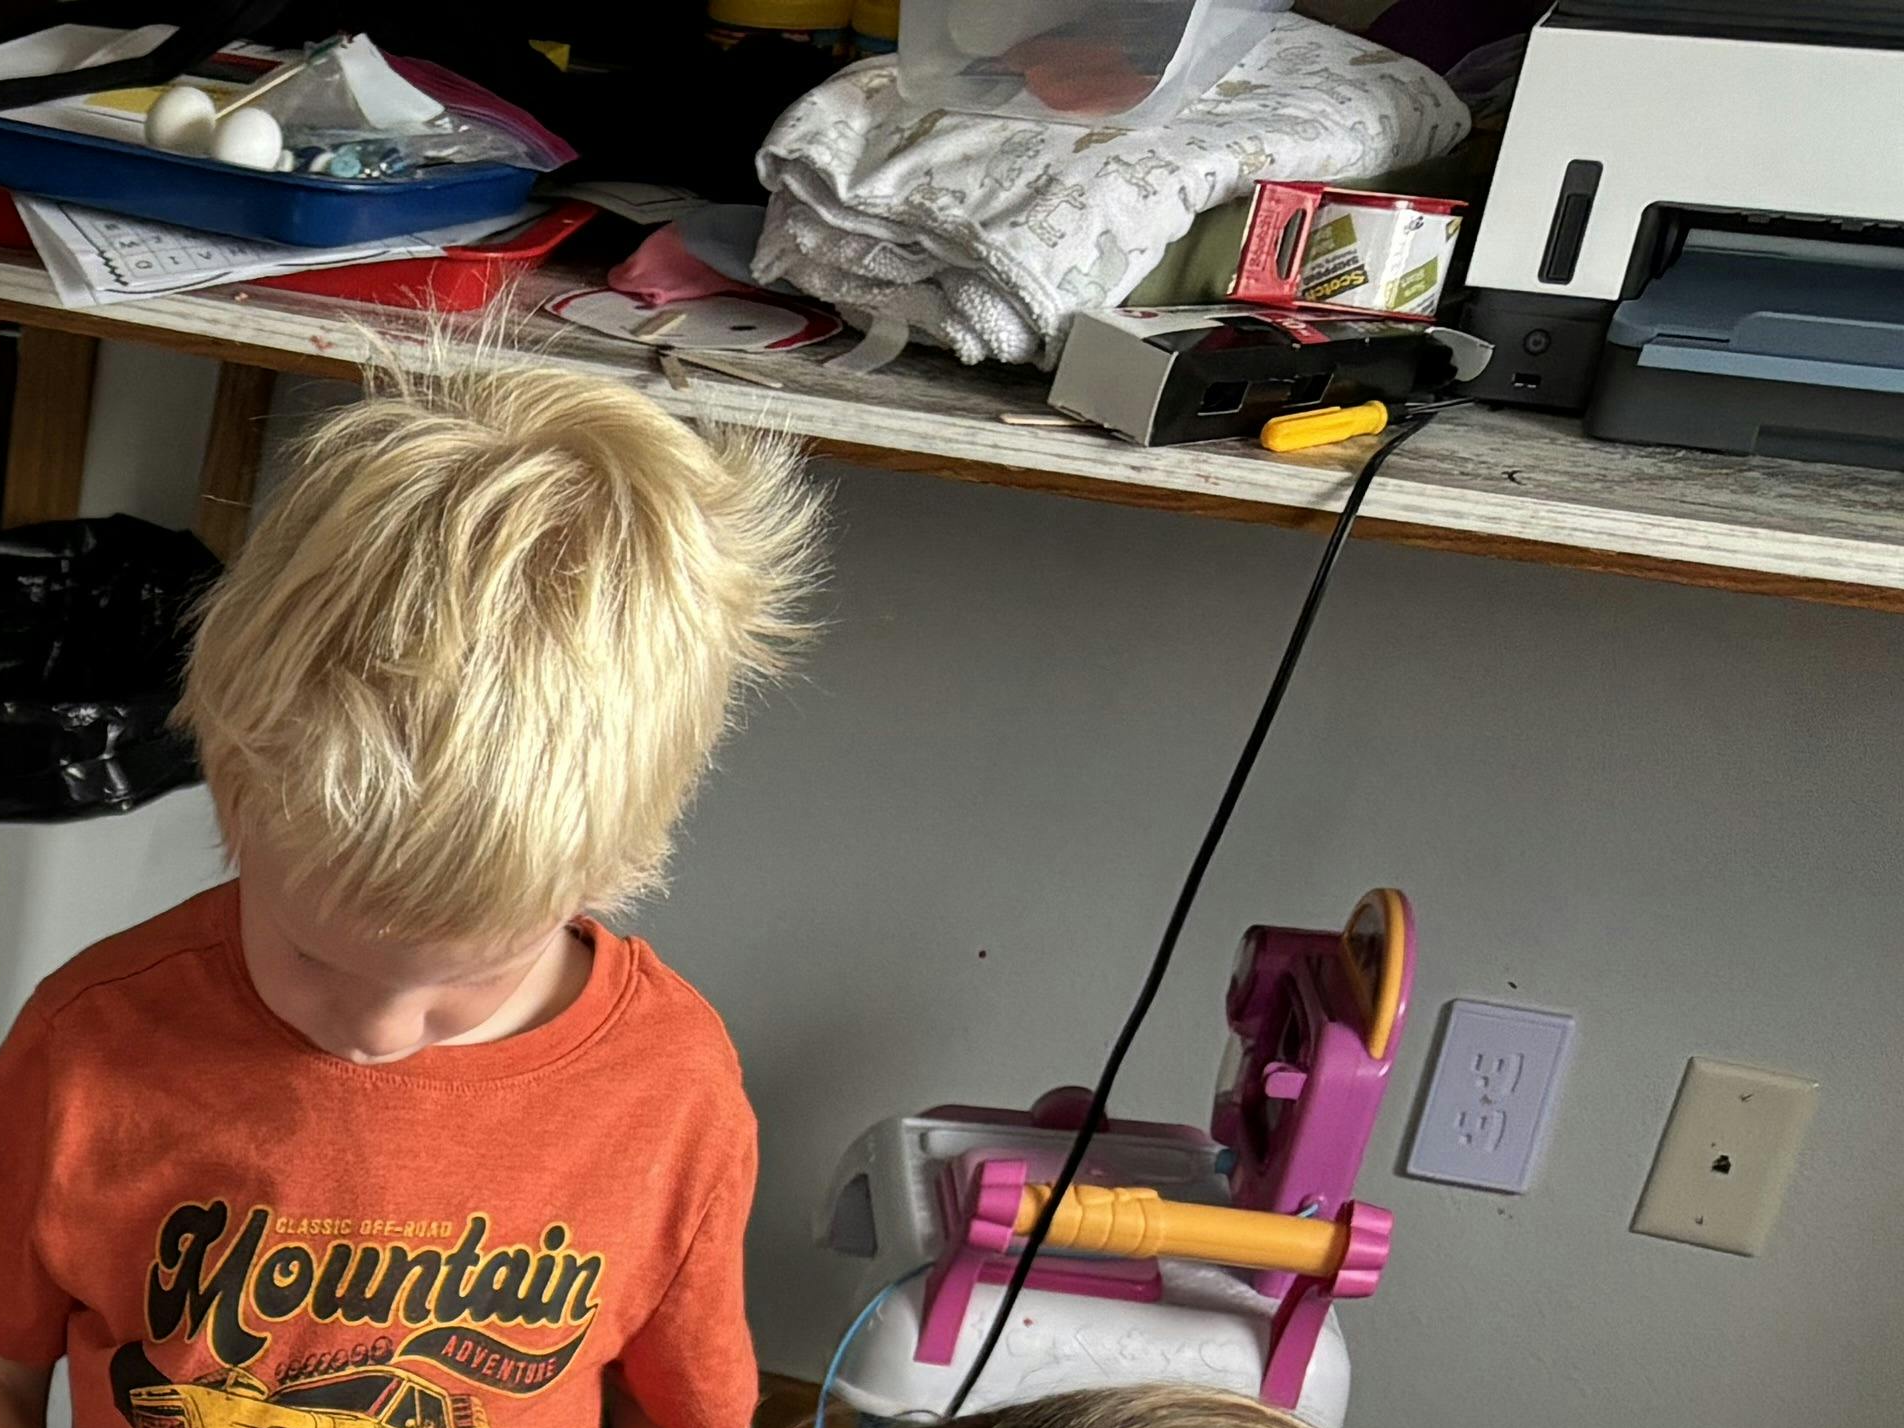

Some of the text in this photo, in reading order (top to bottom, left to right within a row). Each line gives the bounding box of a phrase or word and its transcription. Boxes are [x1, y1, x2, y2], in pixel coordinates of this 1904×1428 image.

[1305, 269, 1366, 302] Scotch
[275, 1217, 454, 1238] CLASSIC OFF-ROAD
[145, 1196, 605, 1366] Mountain
[441, 1334, 557, 1385] ADVENTURE
